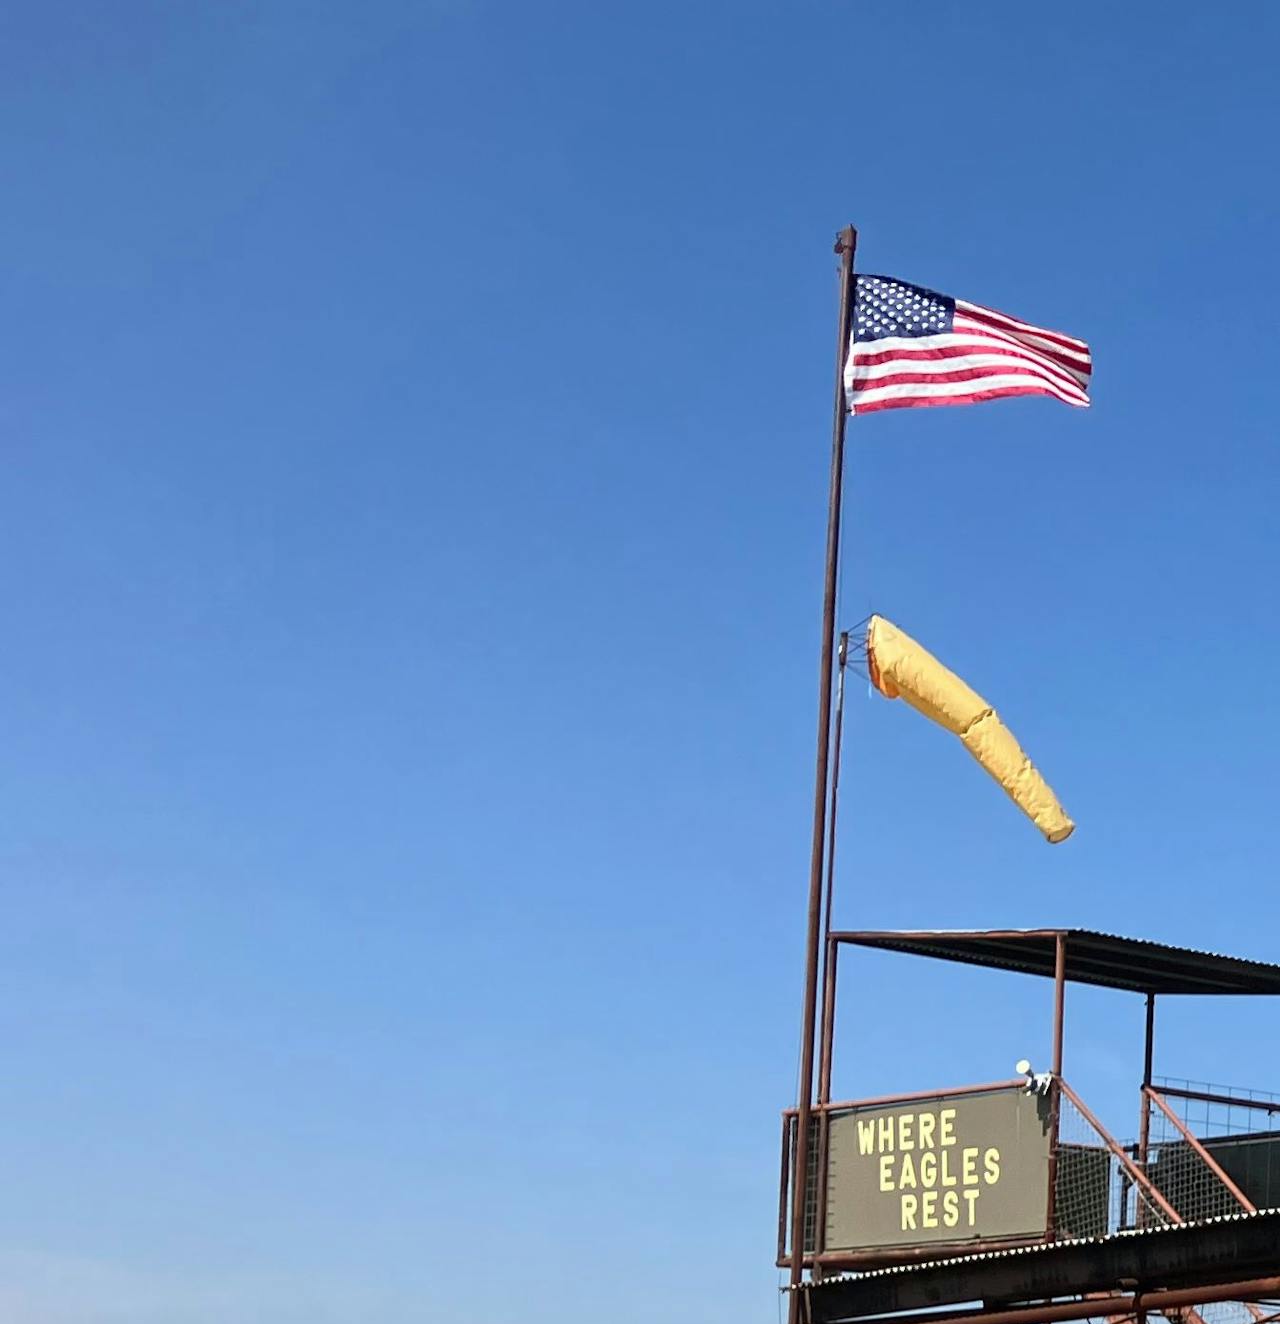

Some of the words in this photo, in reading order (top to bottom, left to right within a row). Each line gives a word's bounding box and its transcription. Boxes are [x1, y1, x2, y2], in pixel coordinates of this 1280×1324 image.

[857, 1109, 956, 1155] WHERE
[879, 1148, 1000, 1192] EAGLES
[901, 1189, 980, 1231] REST
